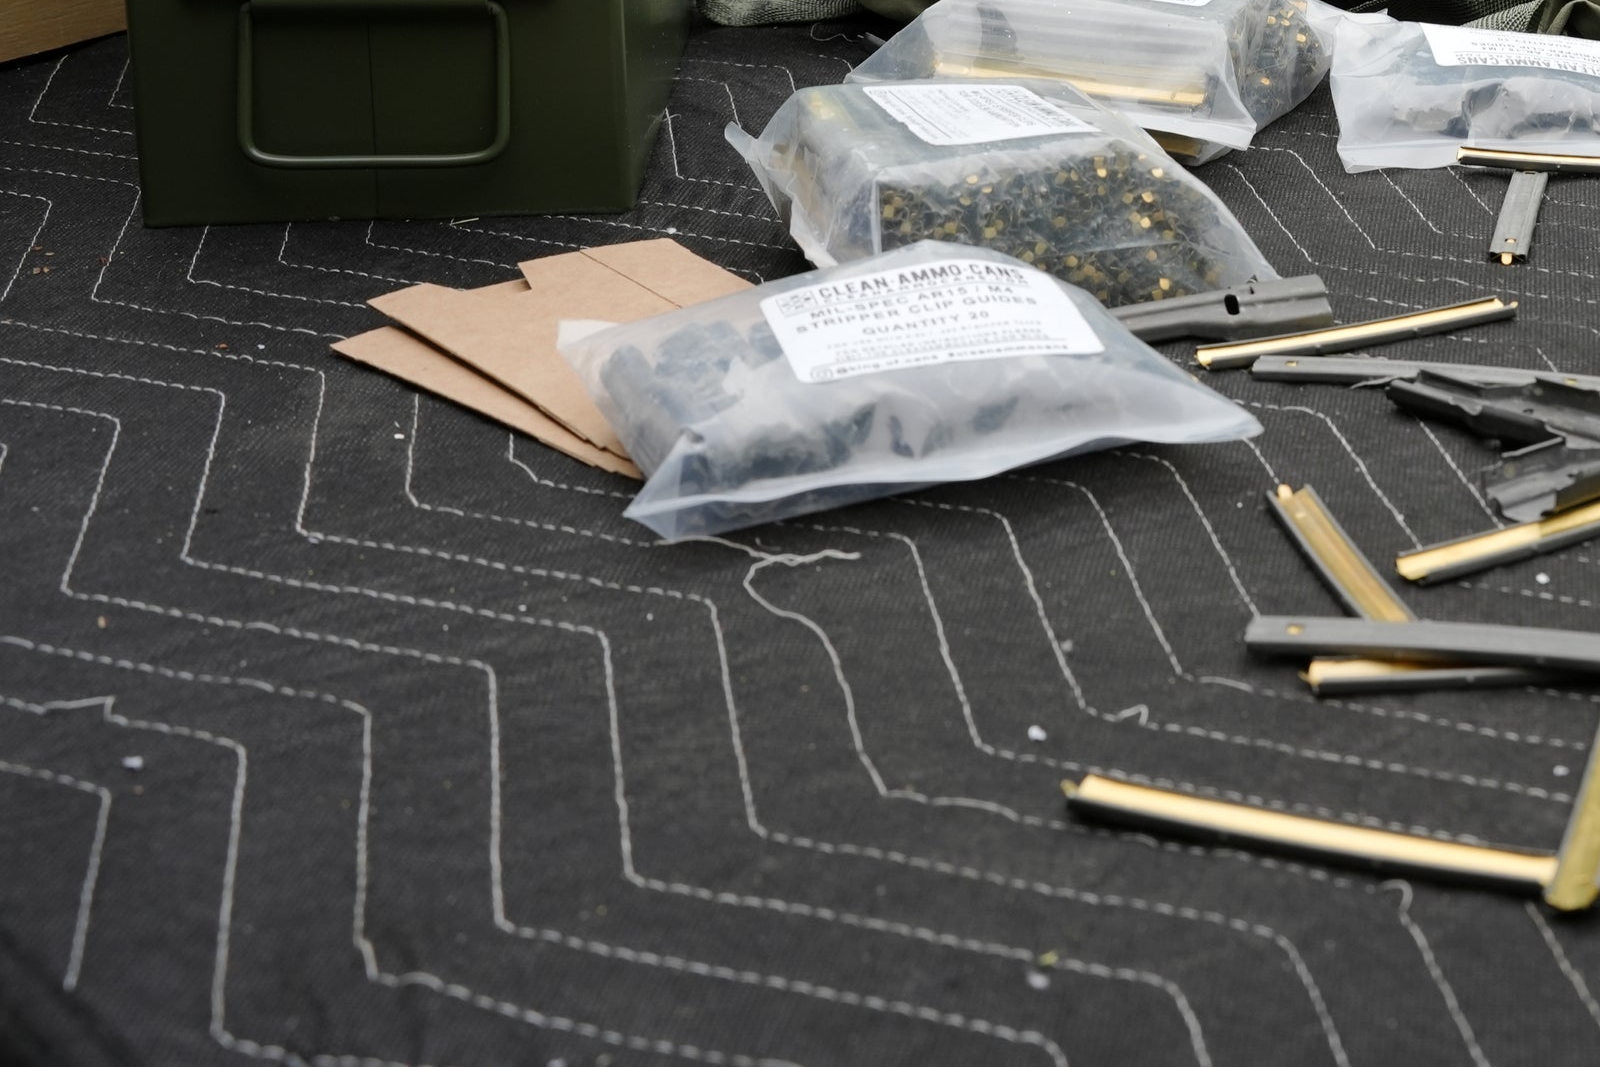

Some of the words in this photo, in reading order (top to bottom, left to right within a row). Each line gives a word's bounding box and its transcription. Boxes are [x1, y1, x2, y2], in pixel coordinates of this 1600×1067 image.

[1455, 56, 1500, 65] CANS
[1503, 56, 1551, 68] AMMO
[819, 276, 890, 299] CLEAN
[898, 263, 962, 285] AMMO
[969, 264, 1025, 280] CANS
[918, 286, 968, 301] AR15
[988, 285, 1015, 294] M4
[796, 308, 901, 334] STRIPPER
[909, 299, 954, 314] CLIP
[962, 294, 1038, 305] GUIDES
[861, 313, 960, 335] QUANTITY
[968, 310, 990, 320] 20
